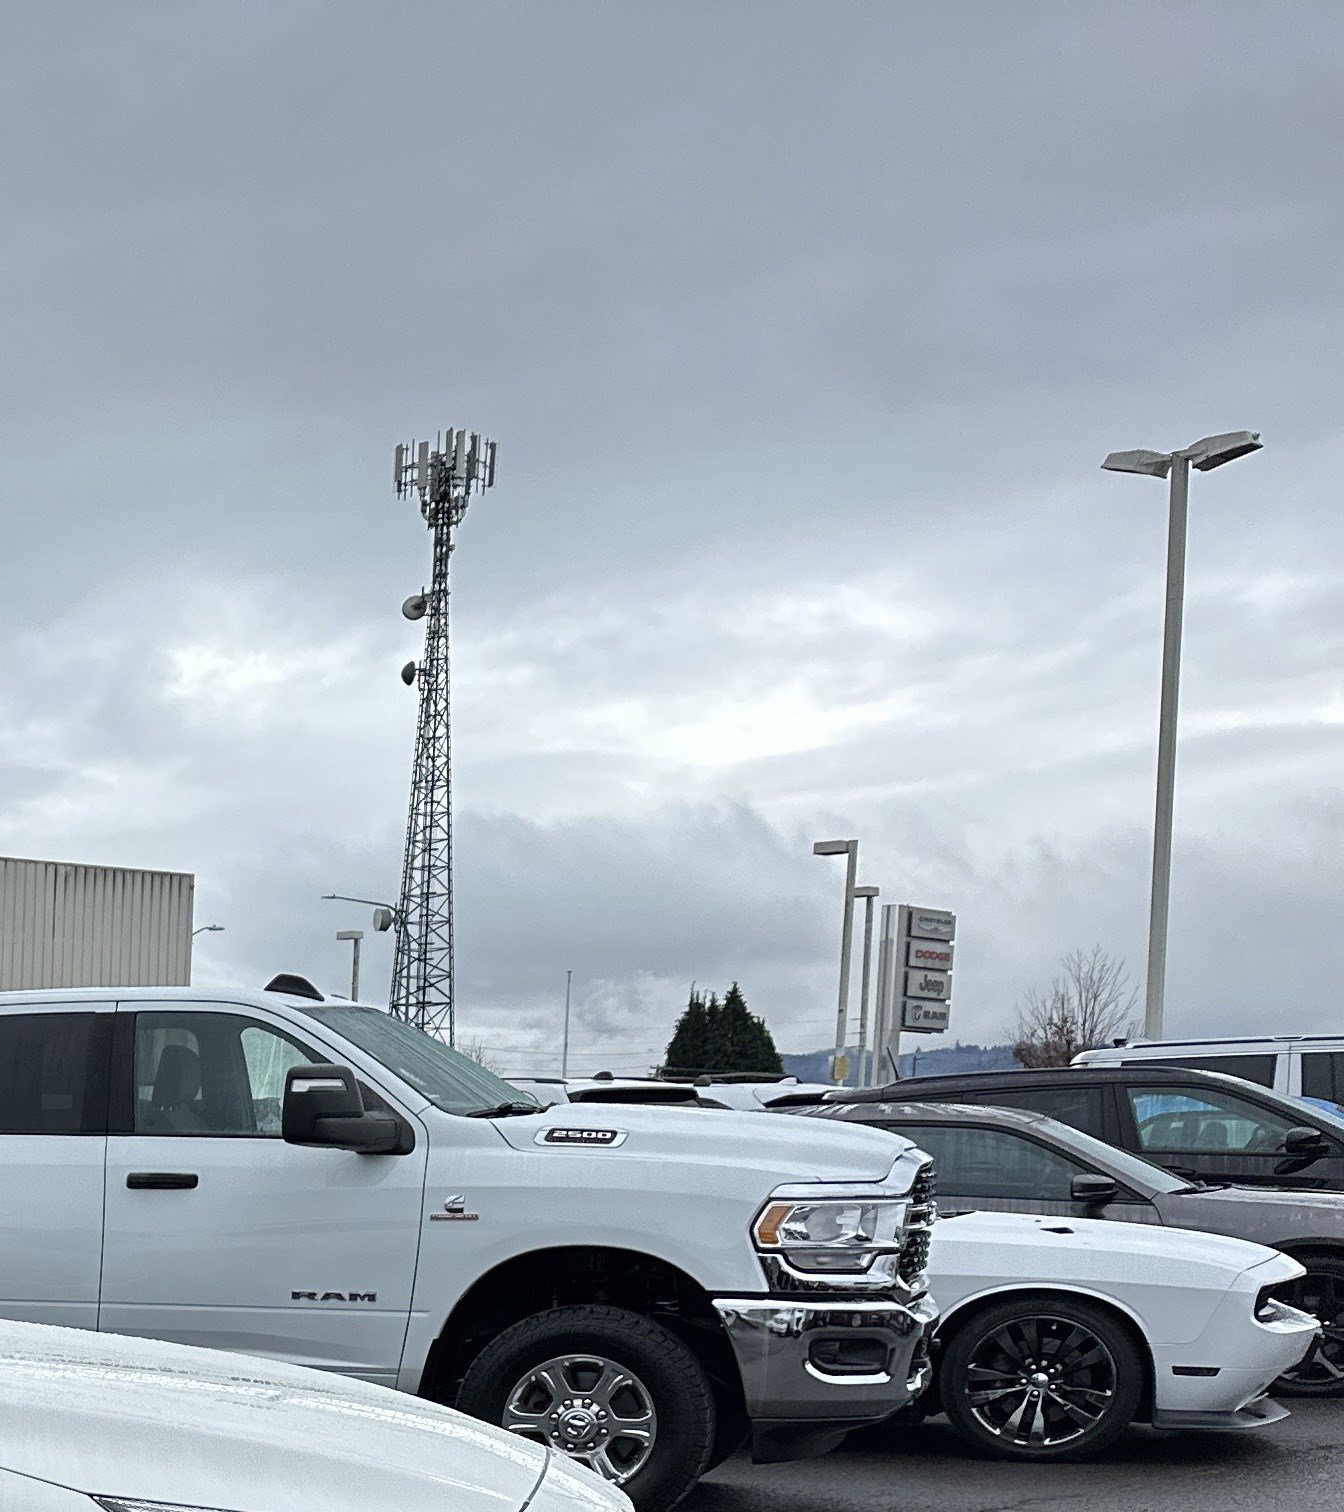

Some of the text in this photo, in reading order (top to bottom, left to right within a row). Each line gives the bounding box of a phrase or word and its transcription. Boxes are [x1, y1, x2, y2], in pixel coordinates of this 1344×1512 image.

[915, 949, 950, 962] DODGE
[919, 973, 944, 996] Jeep
[923, 1010, 947, 1022] RAM
[552, 1130, 612, 1139] 2500
[291, 1291, 377, 1302] RAM
